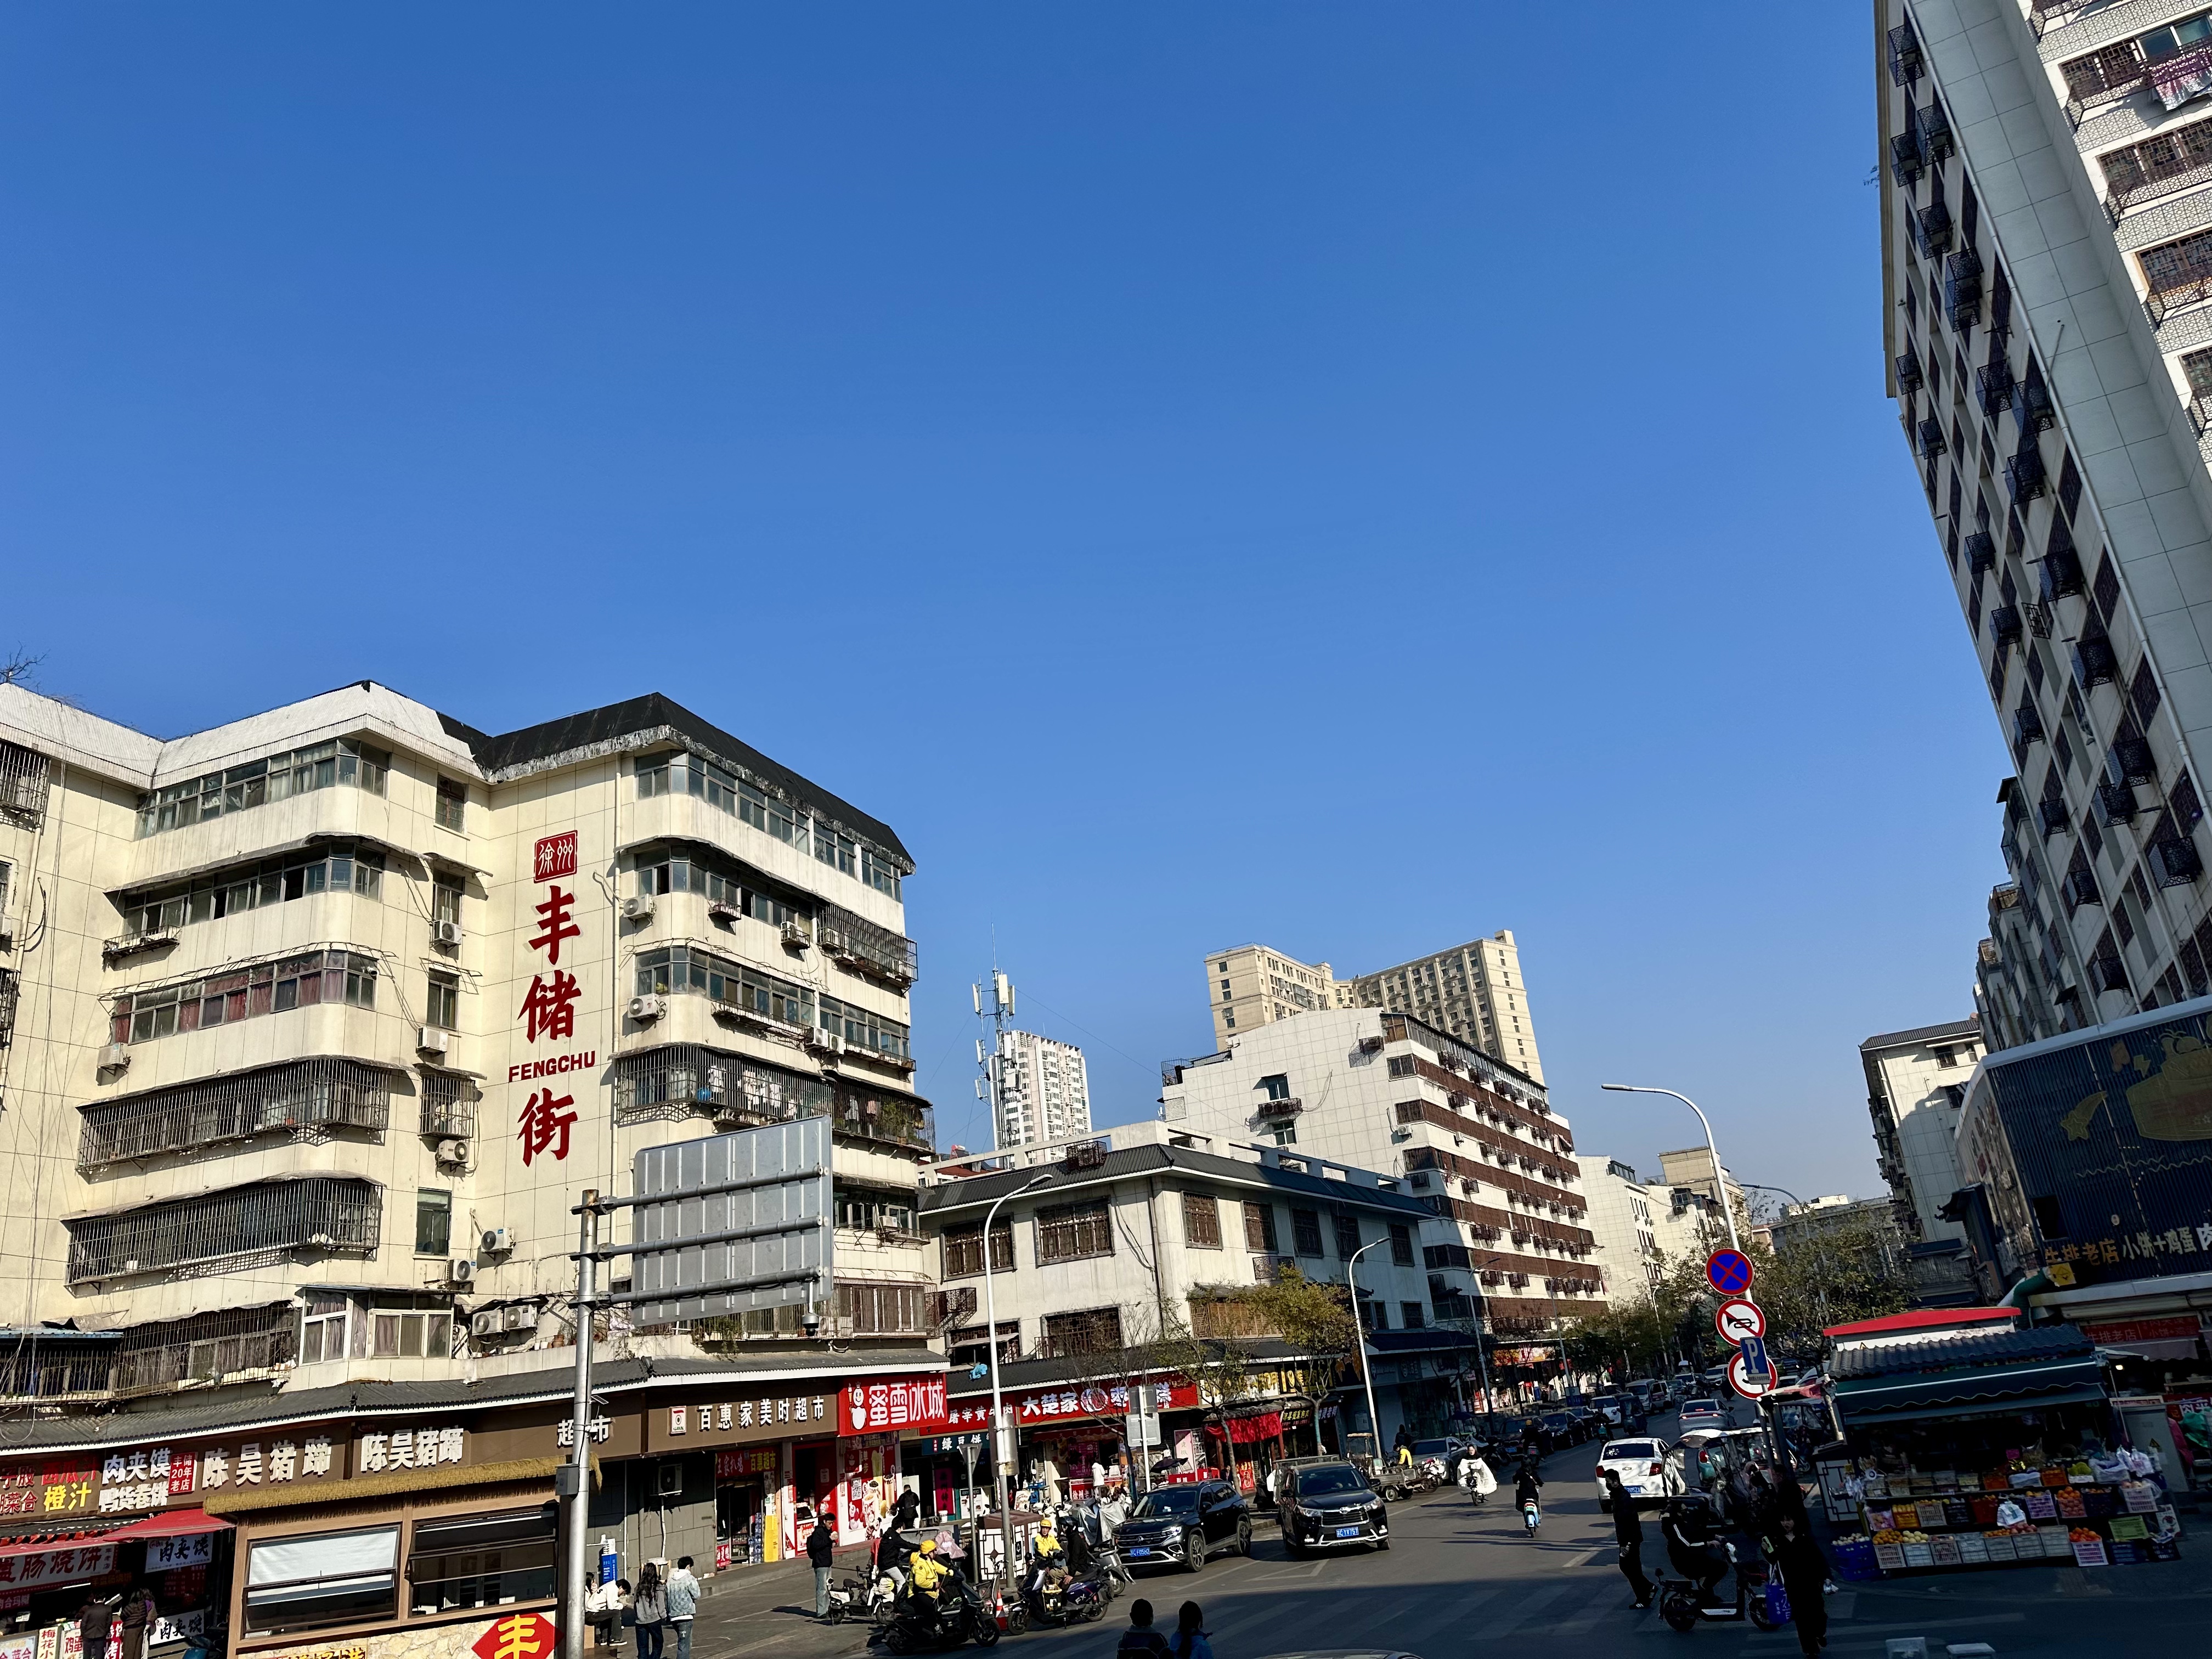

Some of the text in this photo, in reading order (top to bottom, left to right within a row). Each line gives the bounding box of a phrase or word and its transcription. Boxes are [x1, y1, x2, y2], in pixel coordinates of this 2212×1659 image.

[509, 1051, 596, 1084] FENGCHU
[2123, 1226, 2197, 1260] 小饼+鸡蛋
[2087, 1328, 2137, 1345] 牛排老店
[1744, 1339, 1759, 1374] P
[697, 1395, 825, 1431] 百惠家美时超市
[868, 1378, 945, 1426] 蜜雪冰城
[1022, 1391, 1079, 1417] 大楚家
[173, 1454, 193, 1468] 丰储
[202, 1436, 332, 1488] 陈吴猪蹄
[360, 1426, 464, 1472] 陈吴猪蹄
[41, 1455, 99, 1486] 西瓜汁
[102, 1447, 171, 1485] 肉夹馍
[171, 1467, 192, 1479] 20年
[43, 1481, 92, 1513] 橙汁
[99, 1480, 170, 1513] 鸭货卷饼
[170, 1478, 190, 1492] 老店
[159, 1534, 209, 1562] 肉夹馍
[160, 1613, 202, 1640] 肉夹馍
[496, 1614, 541, 1659] 丰
